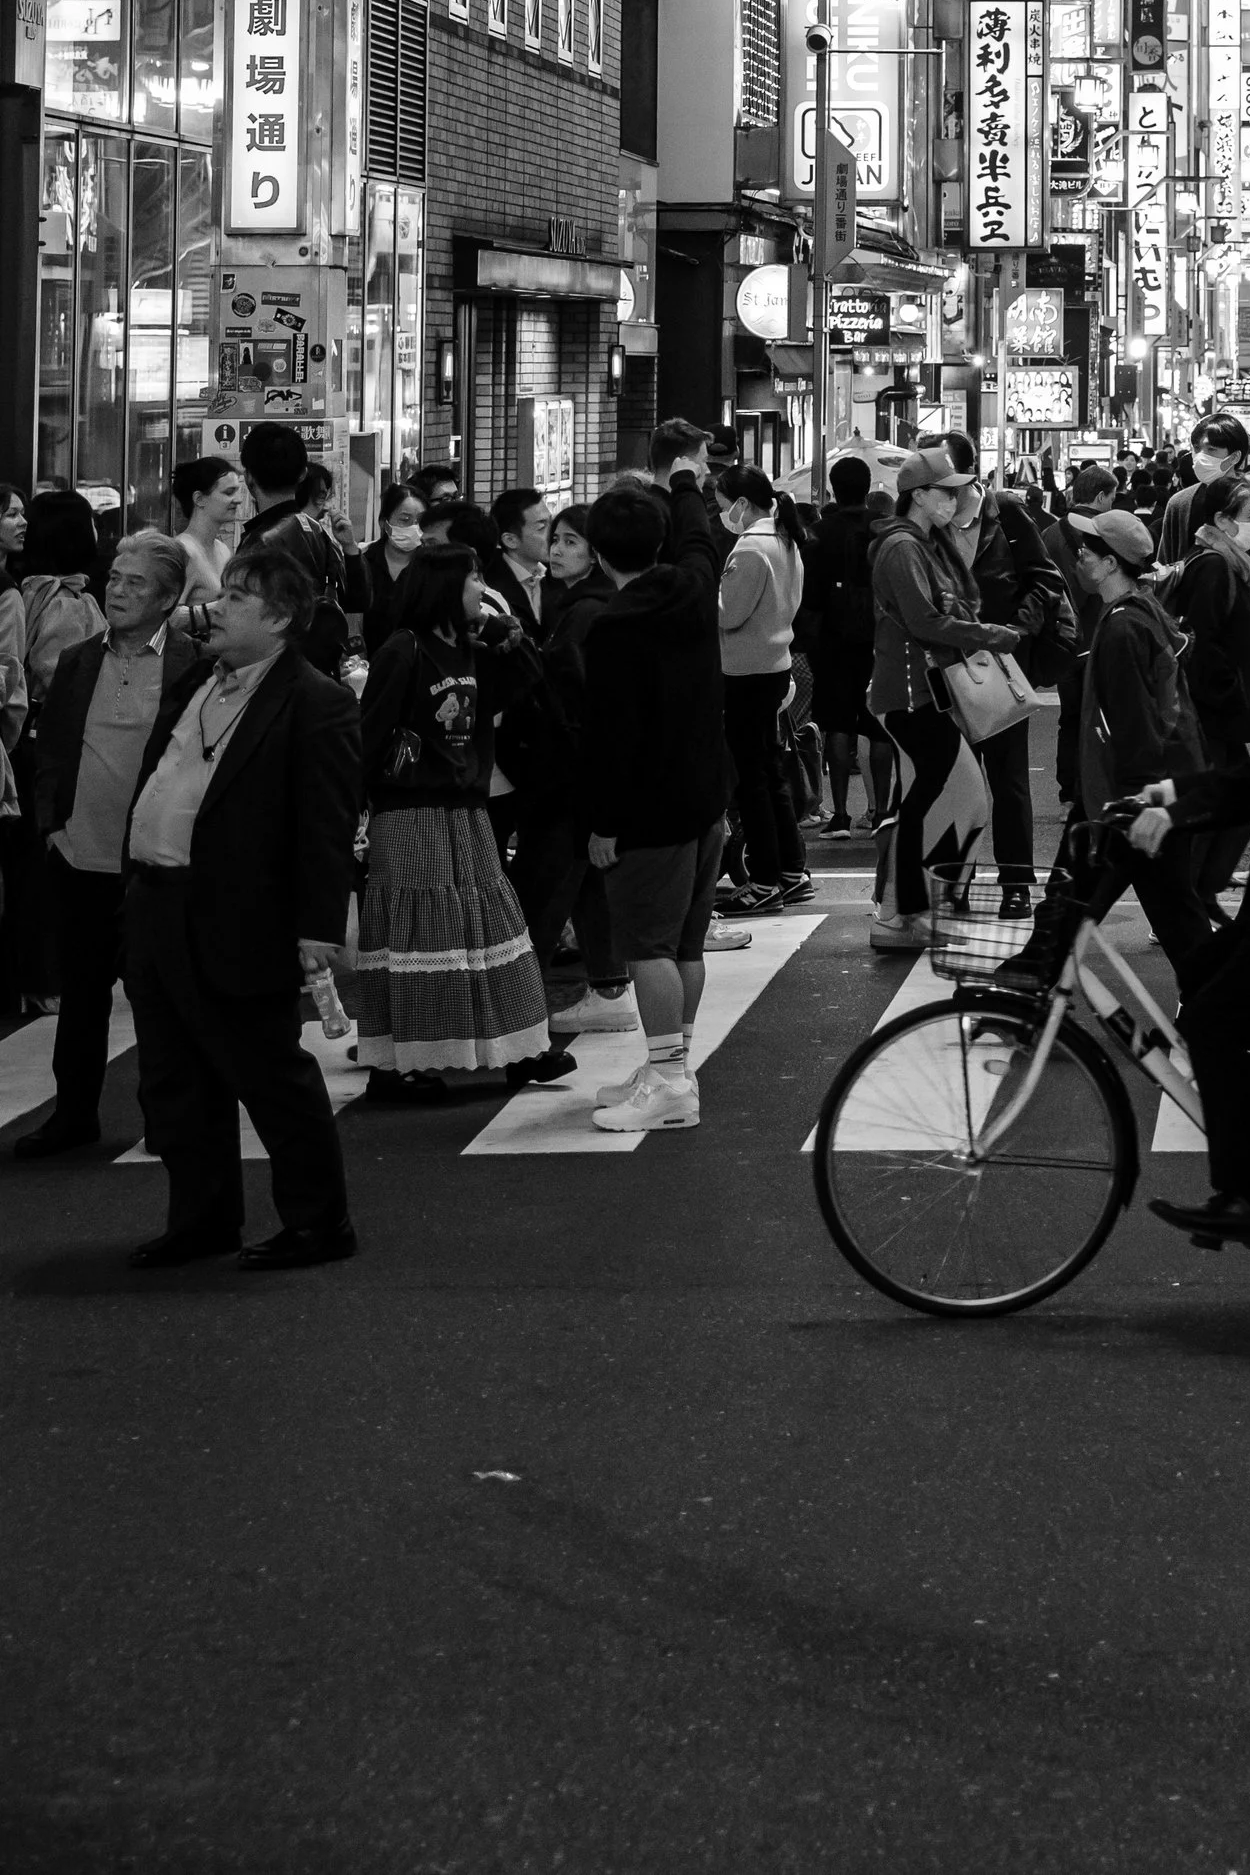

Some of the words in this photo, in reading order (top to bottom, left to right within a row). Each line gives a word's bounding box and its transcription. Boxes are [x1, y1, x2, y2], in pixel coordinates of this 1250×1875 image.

[1027, 9, 1042, 67] 炭火串焼
[855, 152, 877, 162] EEF
[834, 162, 849, 243] 劇場通り一番街
